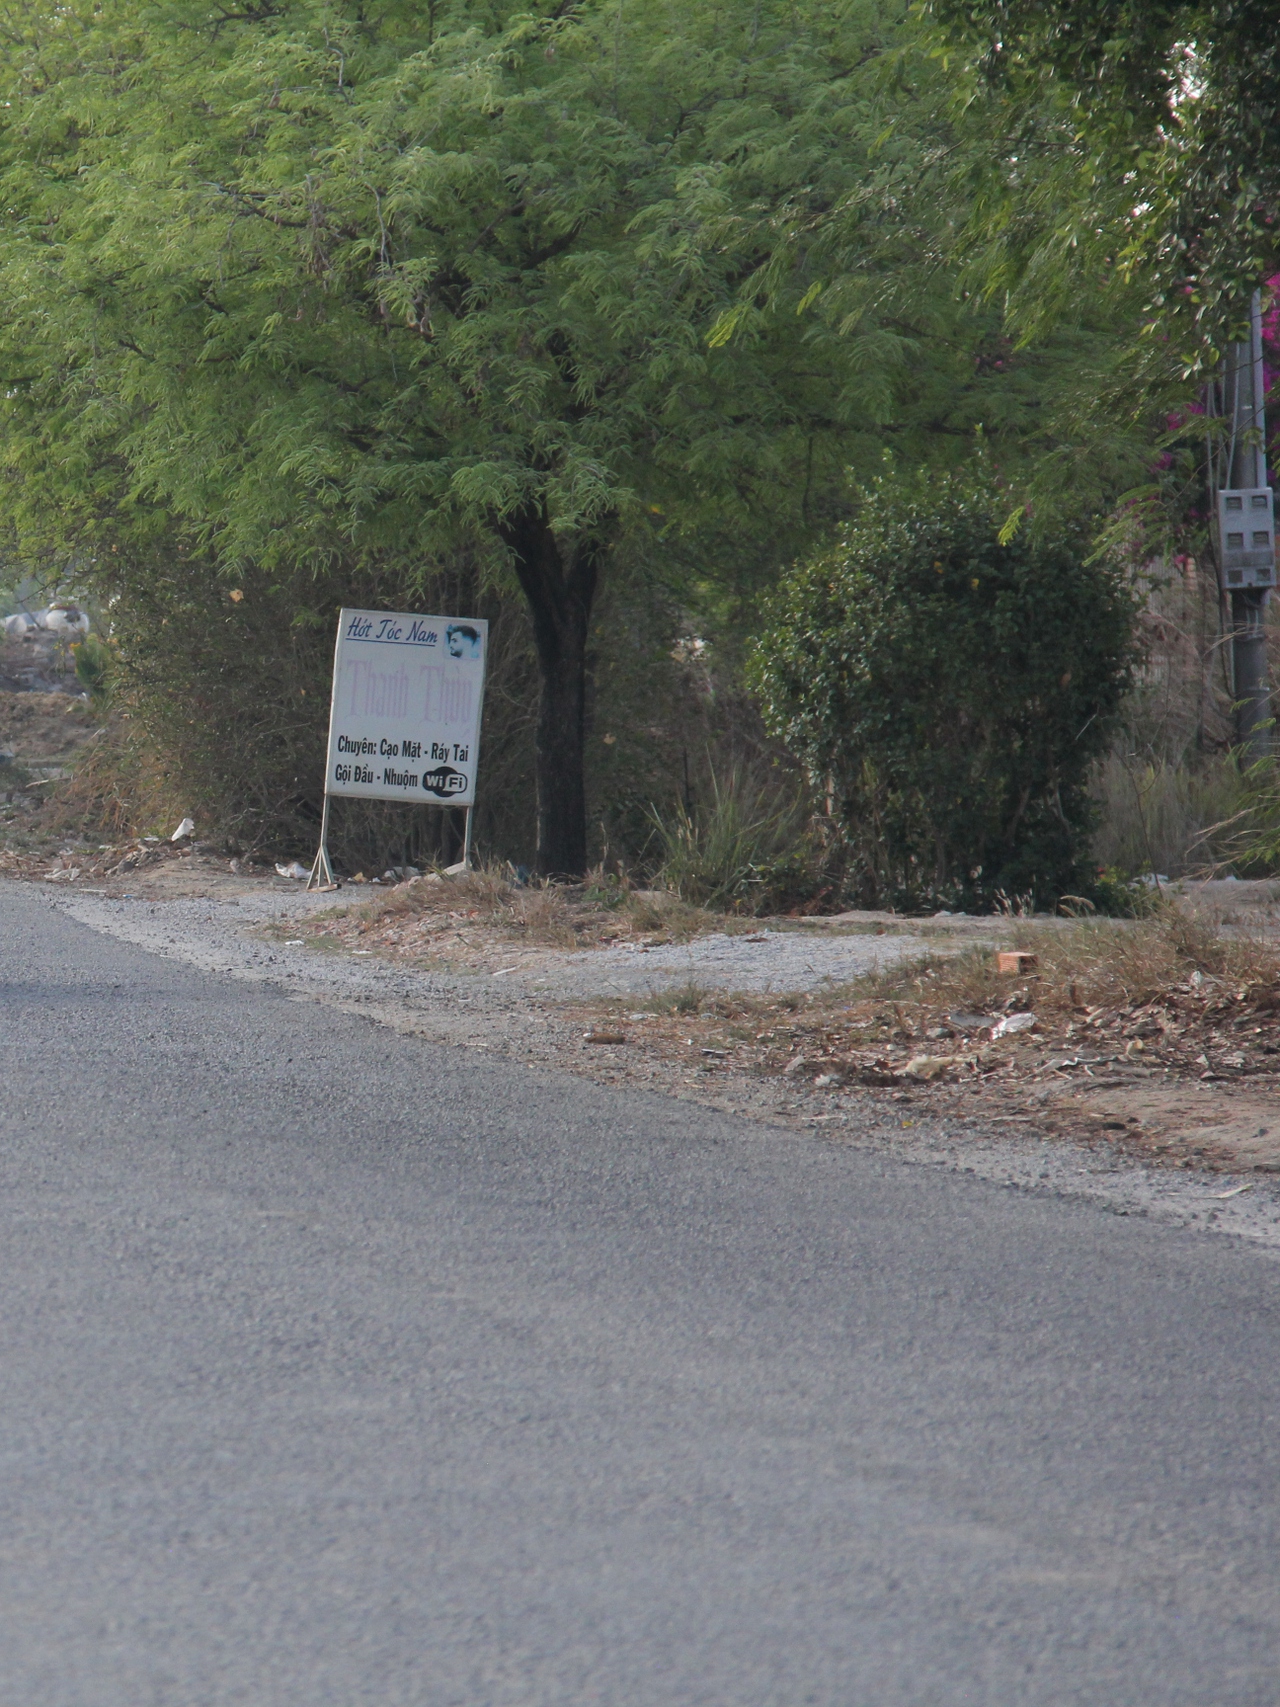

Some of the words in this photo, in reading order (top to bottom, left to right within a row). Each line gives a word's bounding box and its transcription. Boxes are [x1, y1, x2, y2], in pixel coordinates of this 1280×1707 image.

[406, 620, 439, 643] Nam
[337, 735, 377, 757] Chuyên:
[380, 738, 399, 760] Cạo
[401, 740, 422, 763] Mặt
[431, 742, 450, 764] Ráy
[453, 743, 469, 762] Tai
[335, 763, 352, 785] Gội
[354, 763, 373, 783] Đầu
[383, 768, 418, 790] Nhuộm
